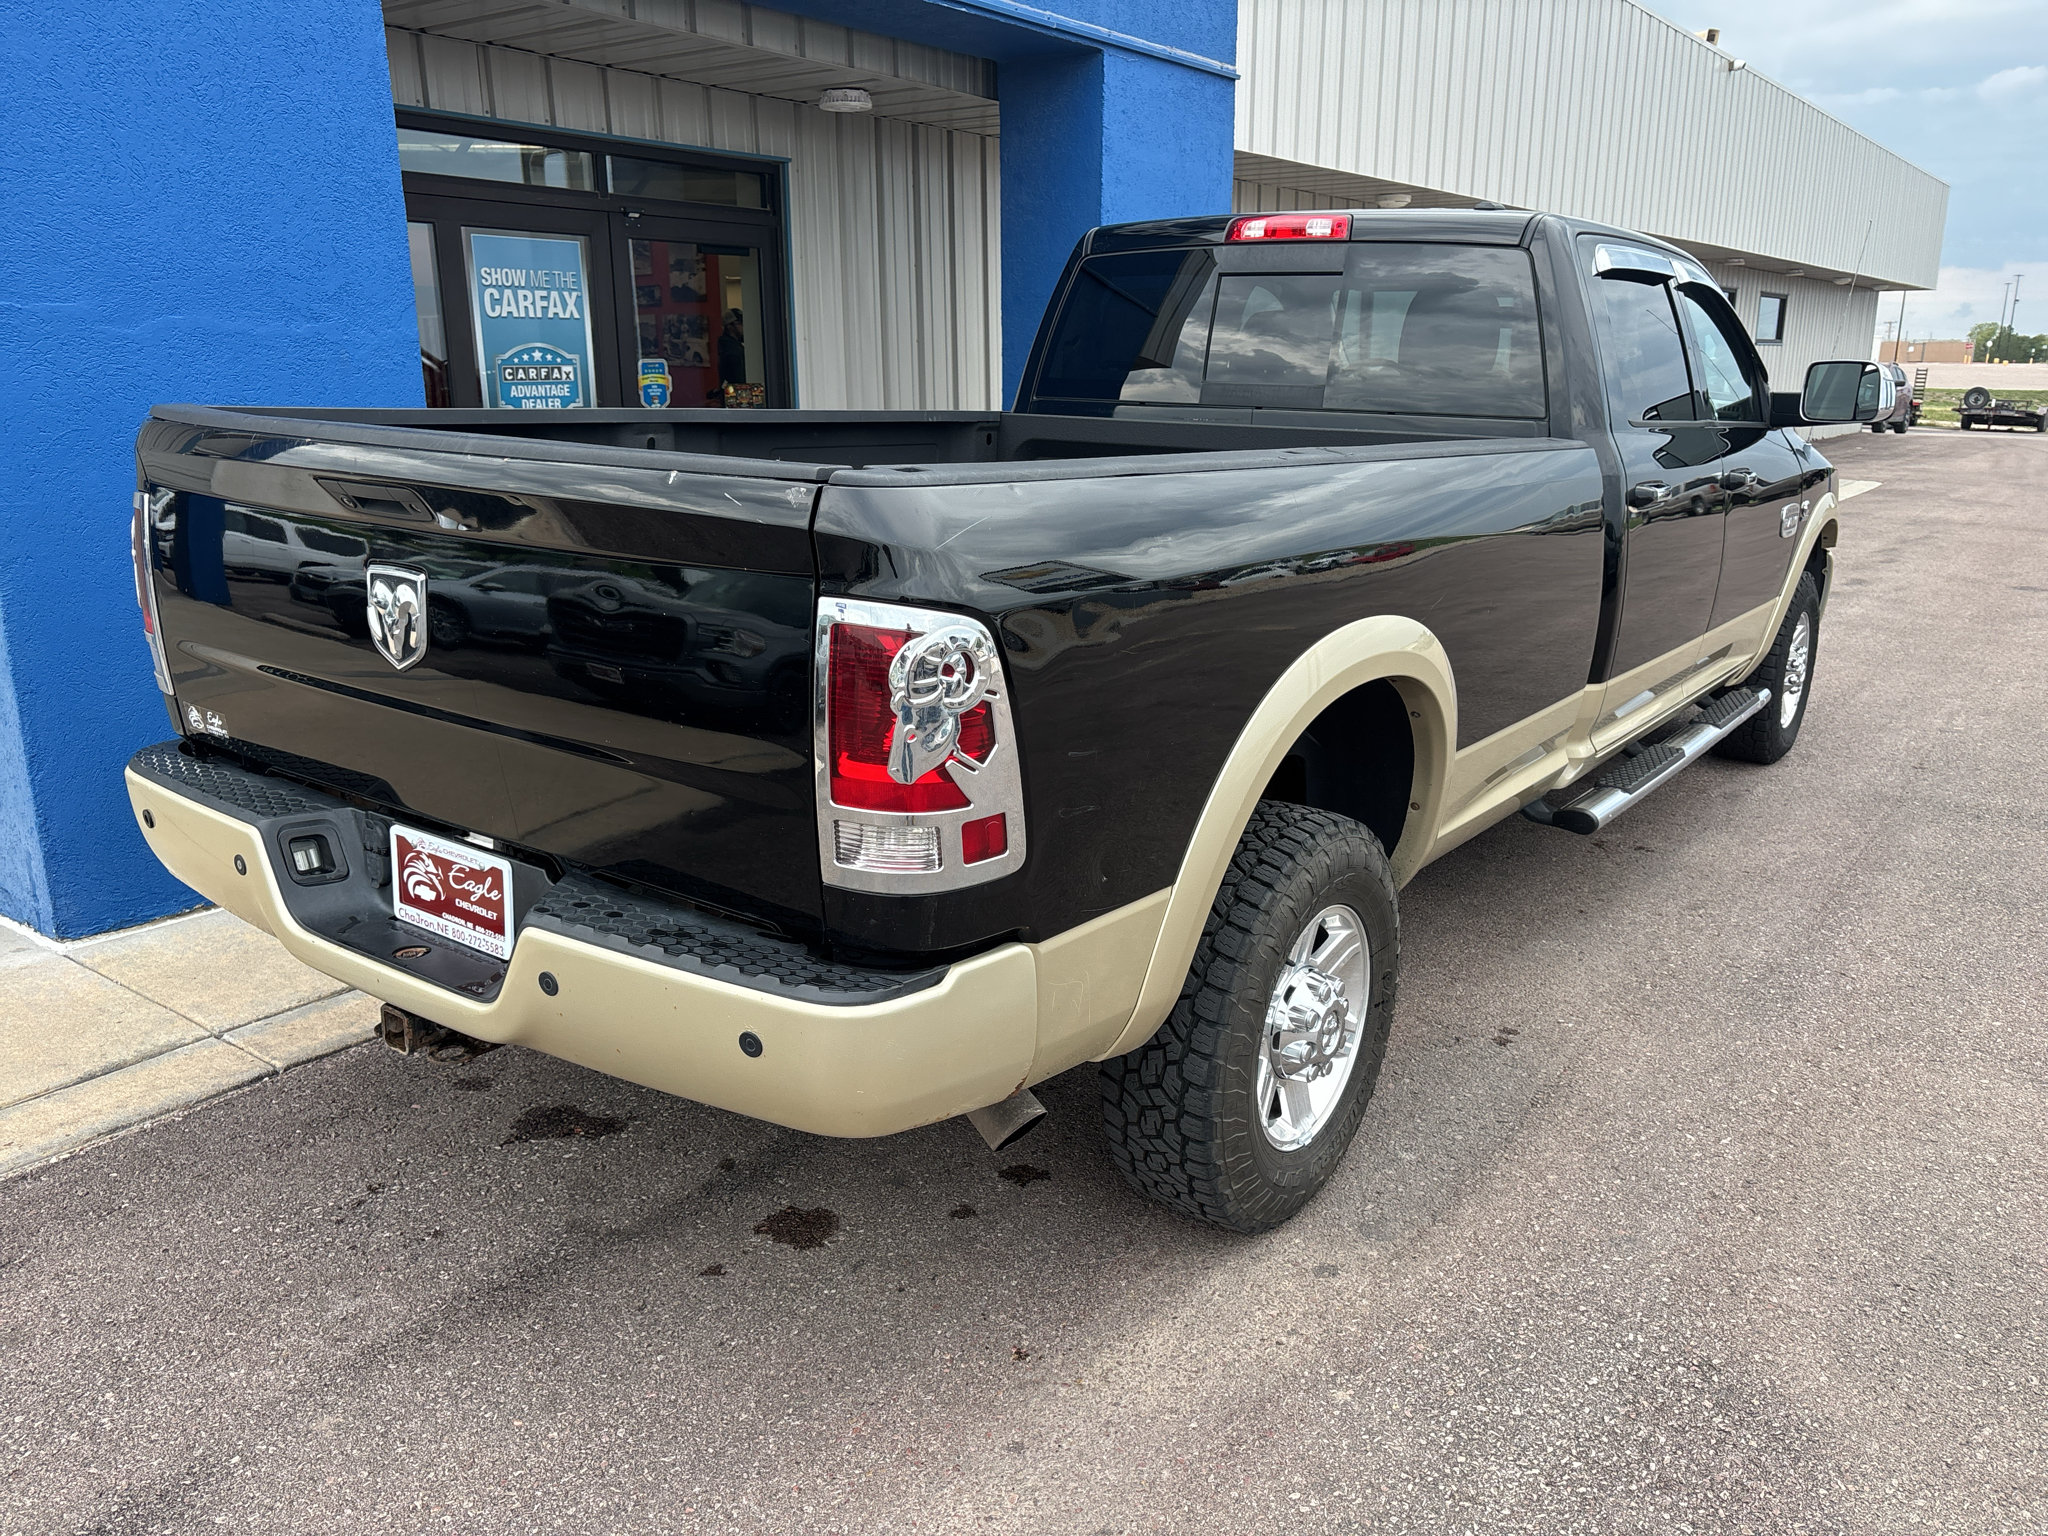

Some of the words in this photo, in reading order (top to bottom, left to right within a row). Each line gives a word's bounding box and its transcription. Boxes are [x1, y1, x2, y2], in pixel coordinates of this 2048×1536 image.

[480, 266, 526, 287] SHOW
[530, 269, 551, 288] ME
[552, 270, 578, 289] THE
[483, 287, 580, 319] CARFAX
[504, 367, 573, 381] CARFAX
[510, 384, 571, 398] ADVANTAGE
[521, 398, 562, 409] DEALER
[448, 863, 502, 902] Eagle
[455, 898, 498, 921] CHEVROLET
